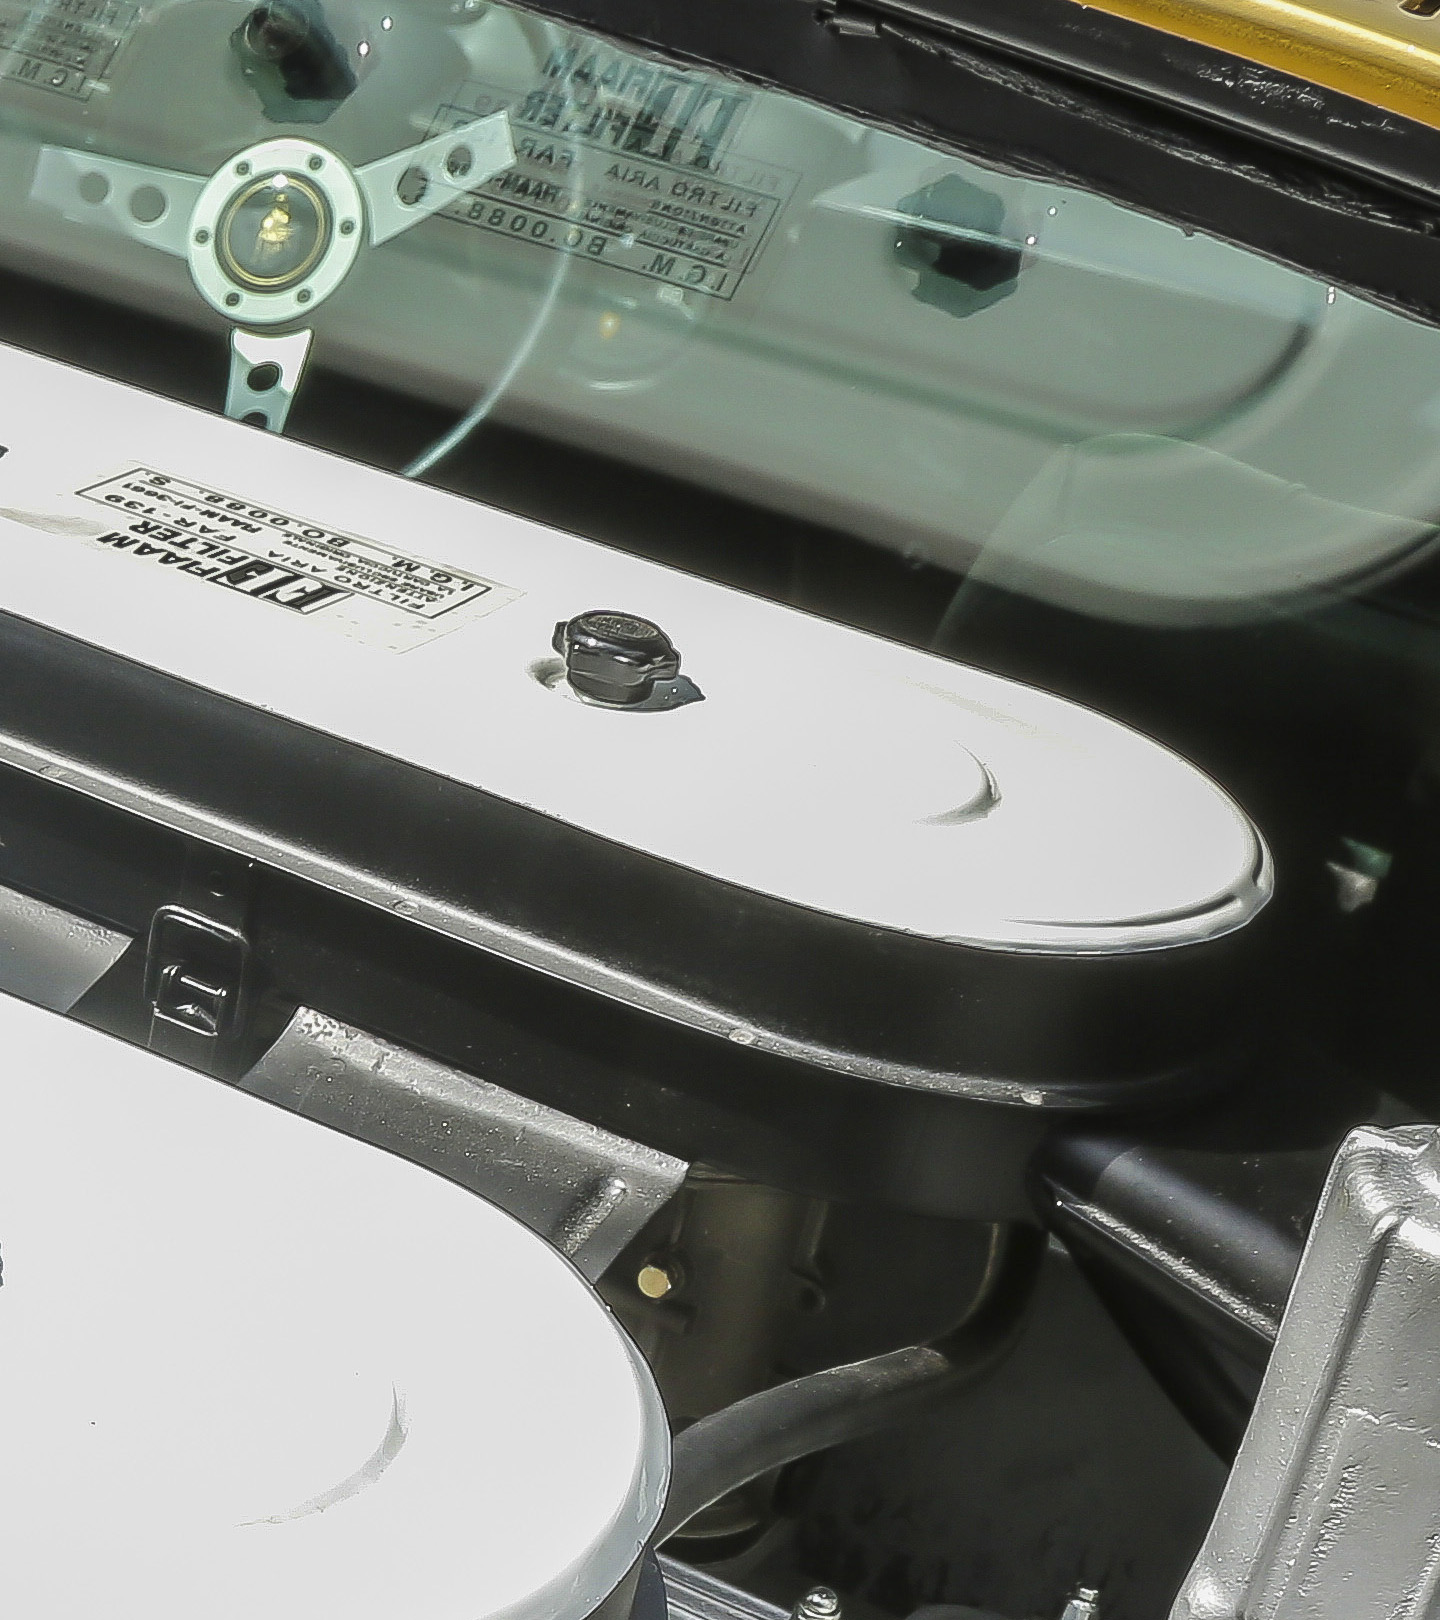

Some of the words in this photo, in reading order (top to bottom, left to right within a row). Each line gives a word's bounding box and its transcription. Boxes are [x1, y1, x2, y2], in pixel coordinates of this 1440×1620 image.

[96, 531, 220, 578] FIAAM
[128, 520, 249, 566] FILTER
[268, 550, 327, 573] ARIA
[334, 575, 425, 610] FILTRO
